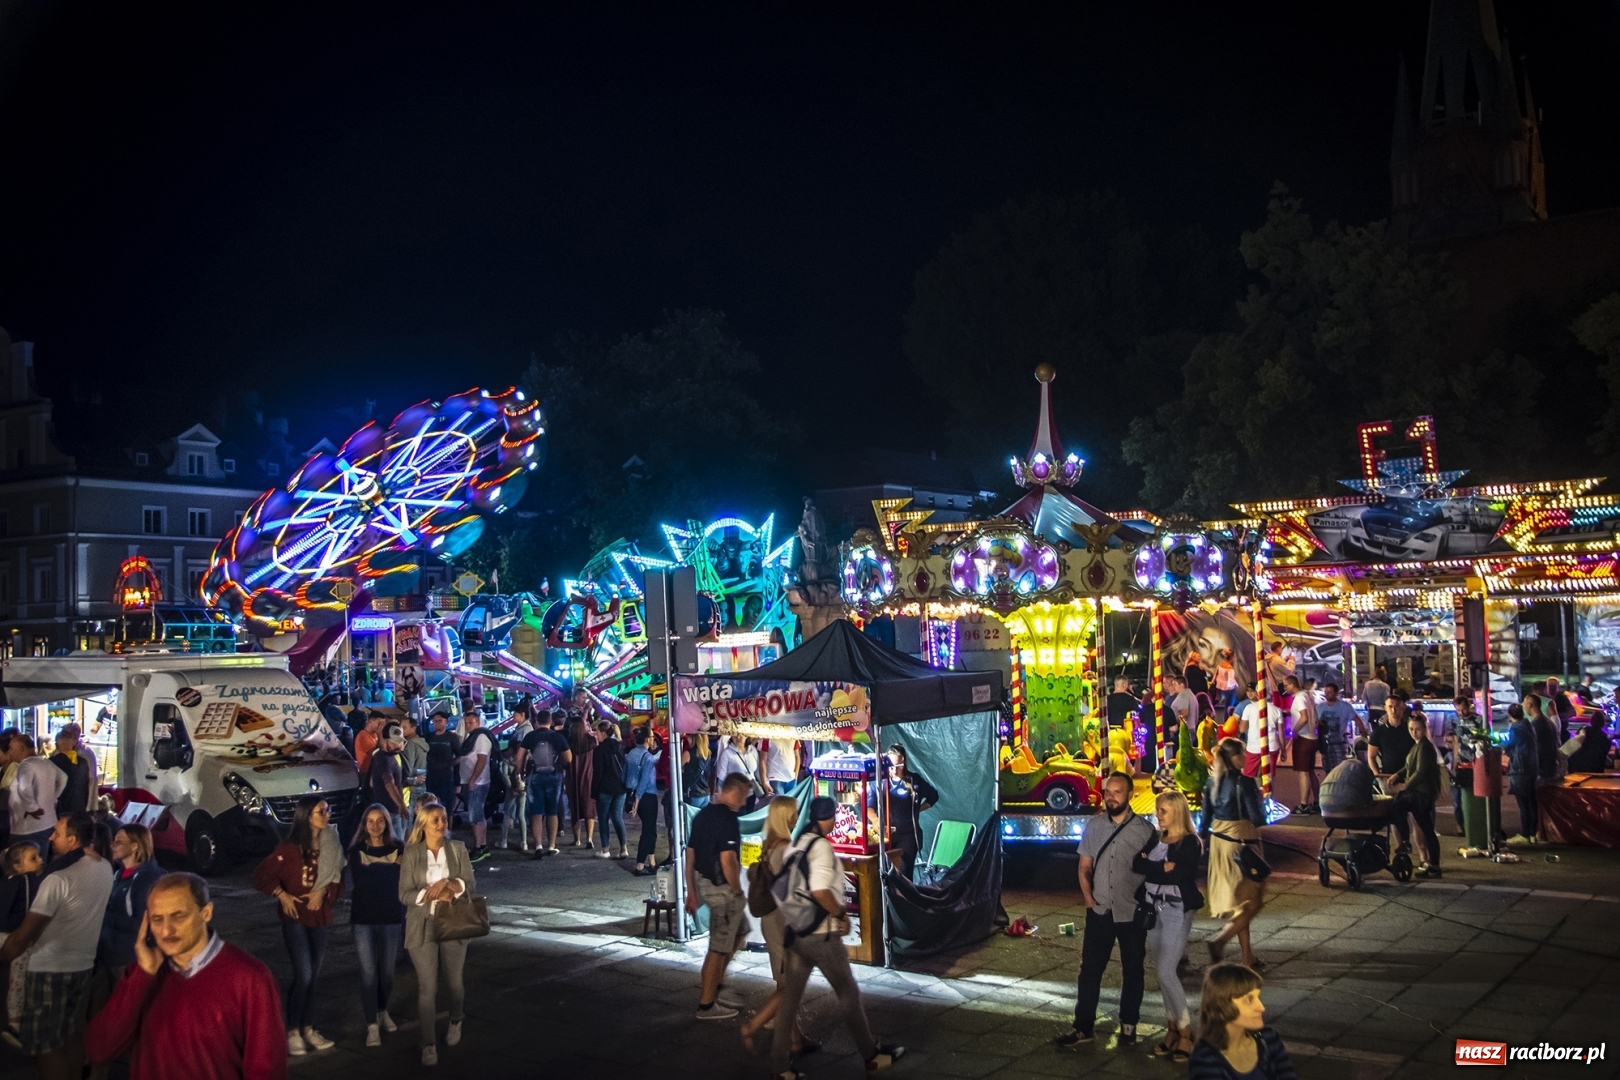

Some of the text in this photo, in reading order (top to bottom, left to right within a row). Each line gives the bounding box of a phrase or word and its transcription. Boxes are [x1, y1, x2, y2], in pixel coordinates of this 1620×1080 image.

[1357, 415, 1440, 487] F1
[964, 628, 1000, 640] 96 22
[215, 684, 314, 705] Zapraszamy
[282, 703, 320, 716] pyszne
[713, 688, 818, 720] CUKROWA
[814, 704, 858, 719] najlepsze
[796, 721, 813, 735] pod
